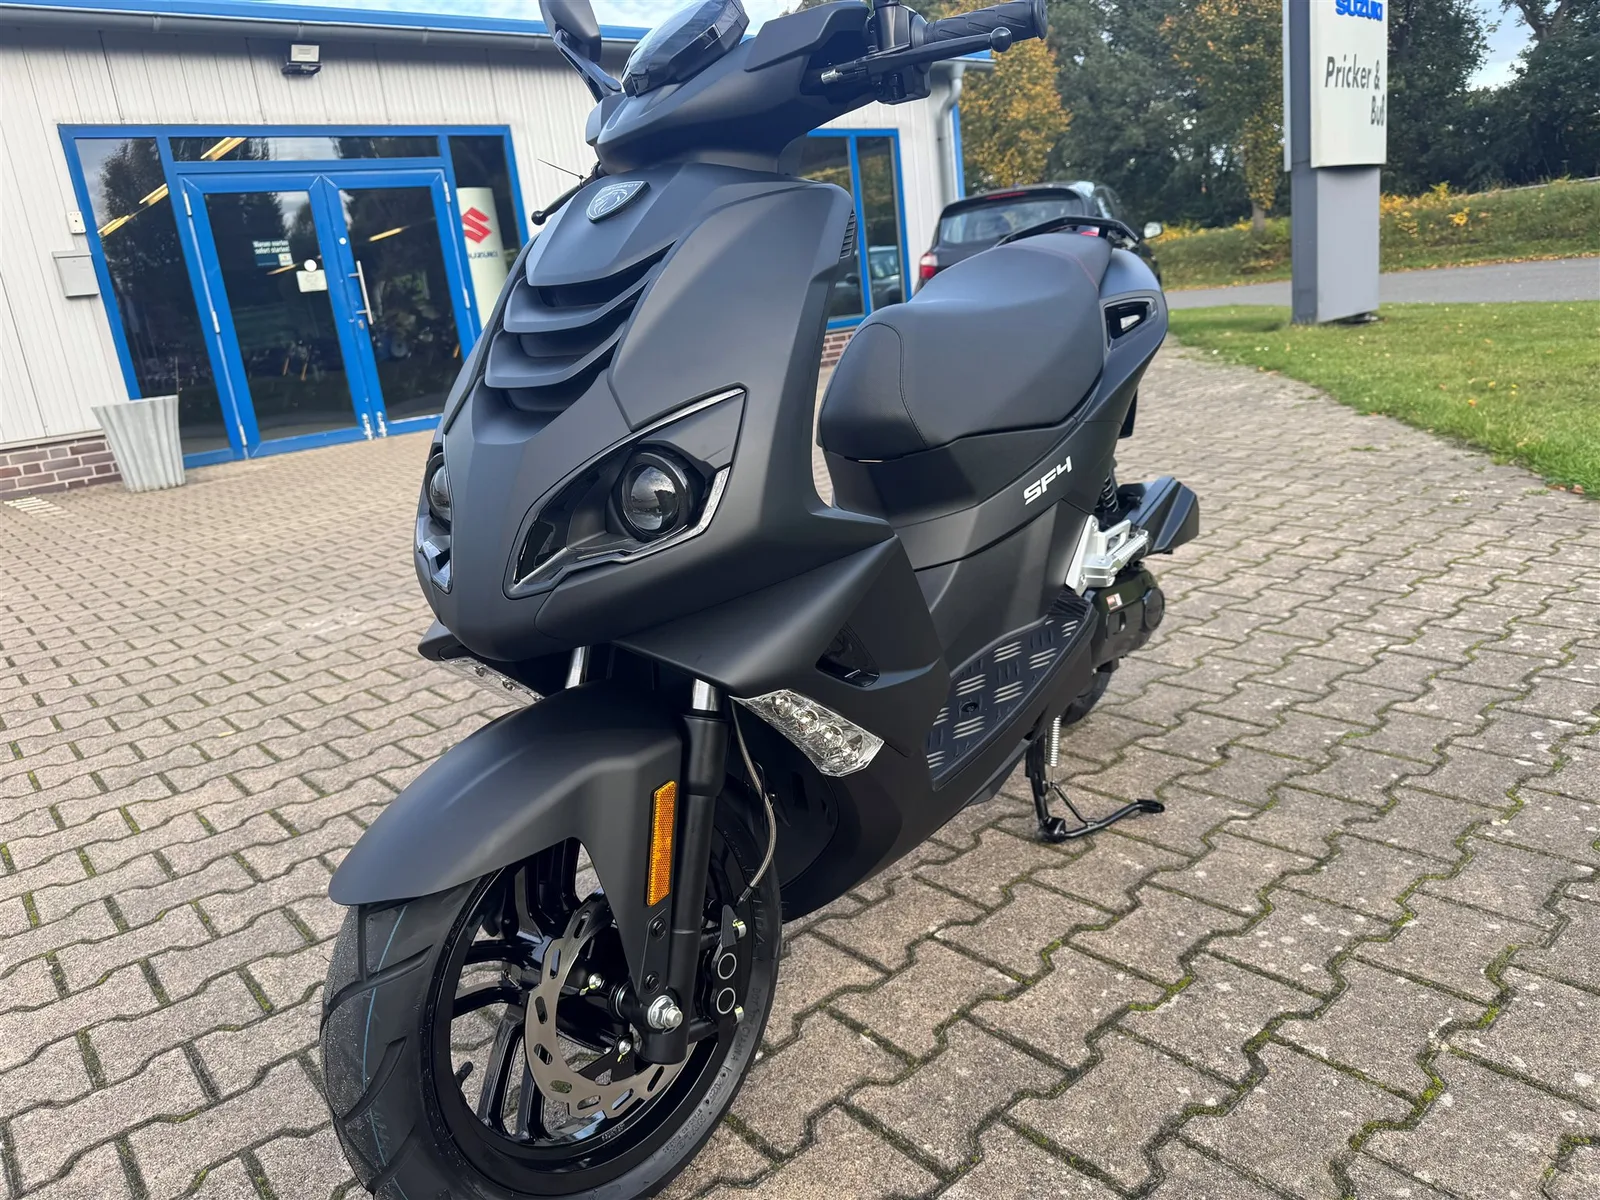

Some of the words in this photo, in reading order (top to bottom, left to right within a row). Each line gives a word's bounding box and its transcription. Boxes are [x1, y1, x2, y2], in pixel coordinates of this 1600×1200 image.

[1335, 0, 1383, 21] SUZUKI
[1324, 54, 1372, 89] Pricker
[1373, 60, 1381, 90] &
[1023, 455, 1072, 505] SF4
